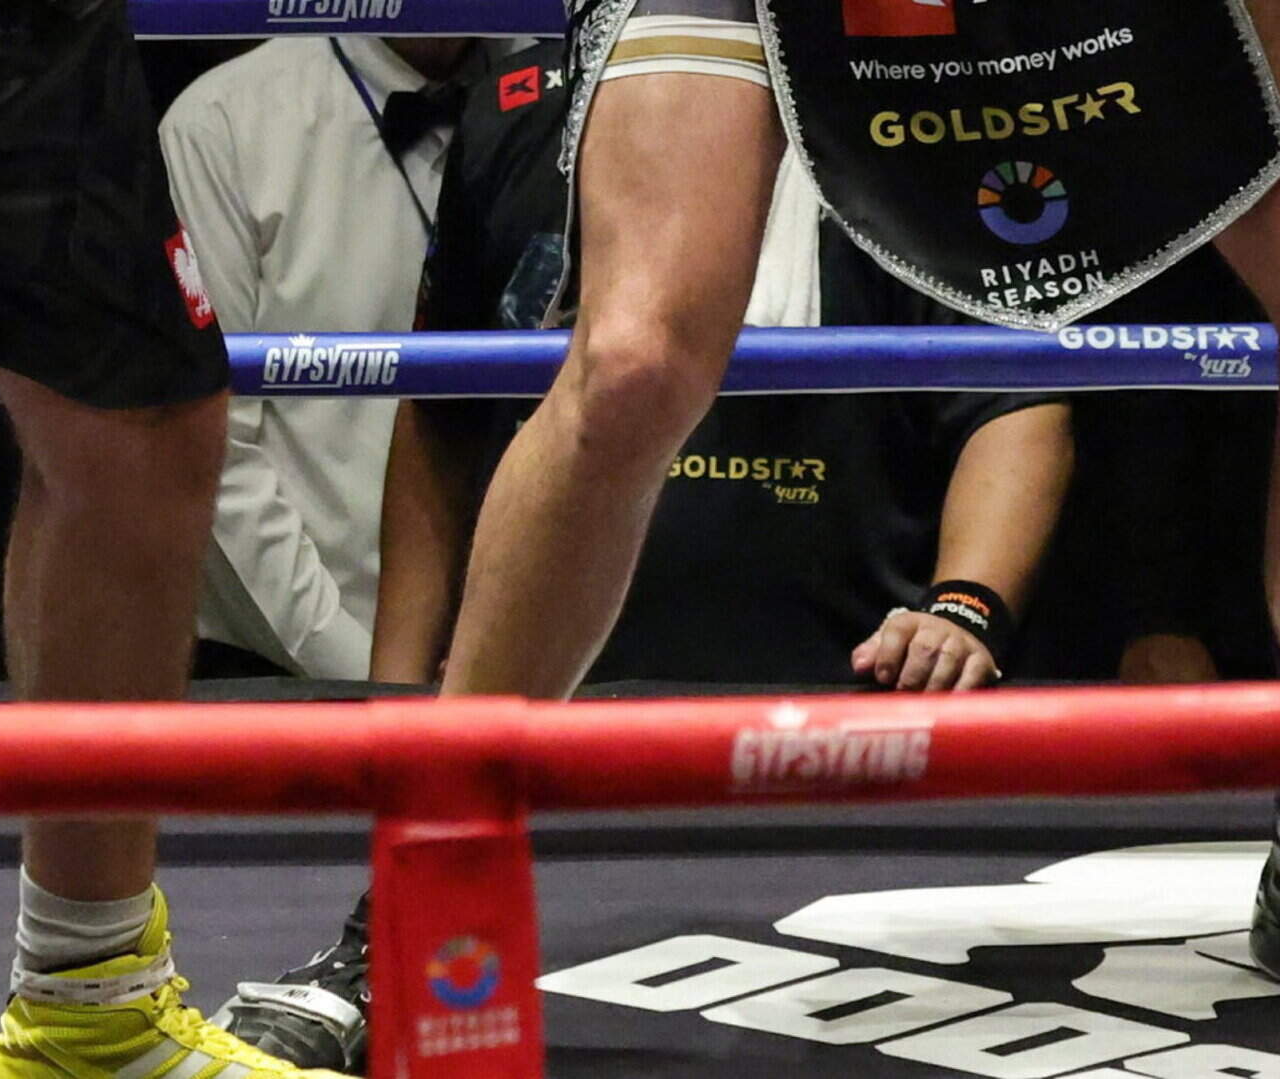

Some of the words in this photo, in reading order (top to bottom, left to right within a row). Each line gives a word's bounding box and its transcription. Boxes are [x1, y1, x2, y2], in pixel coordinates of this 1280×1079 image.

[850, 59, 925, 81] Where
[929, 60, 974, 83] you
[977, 49, 1058, 77] money
[1061, 26, 1134, 61] works
[981, 249, 1099, 288] RIYADH
[987, 270, 1104, 309] SEASON
